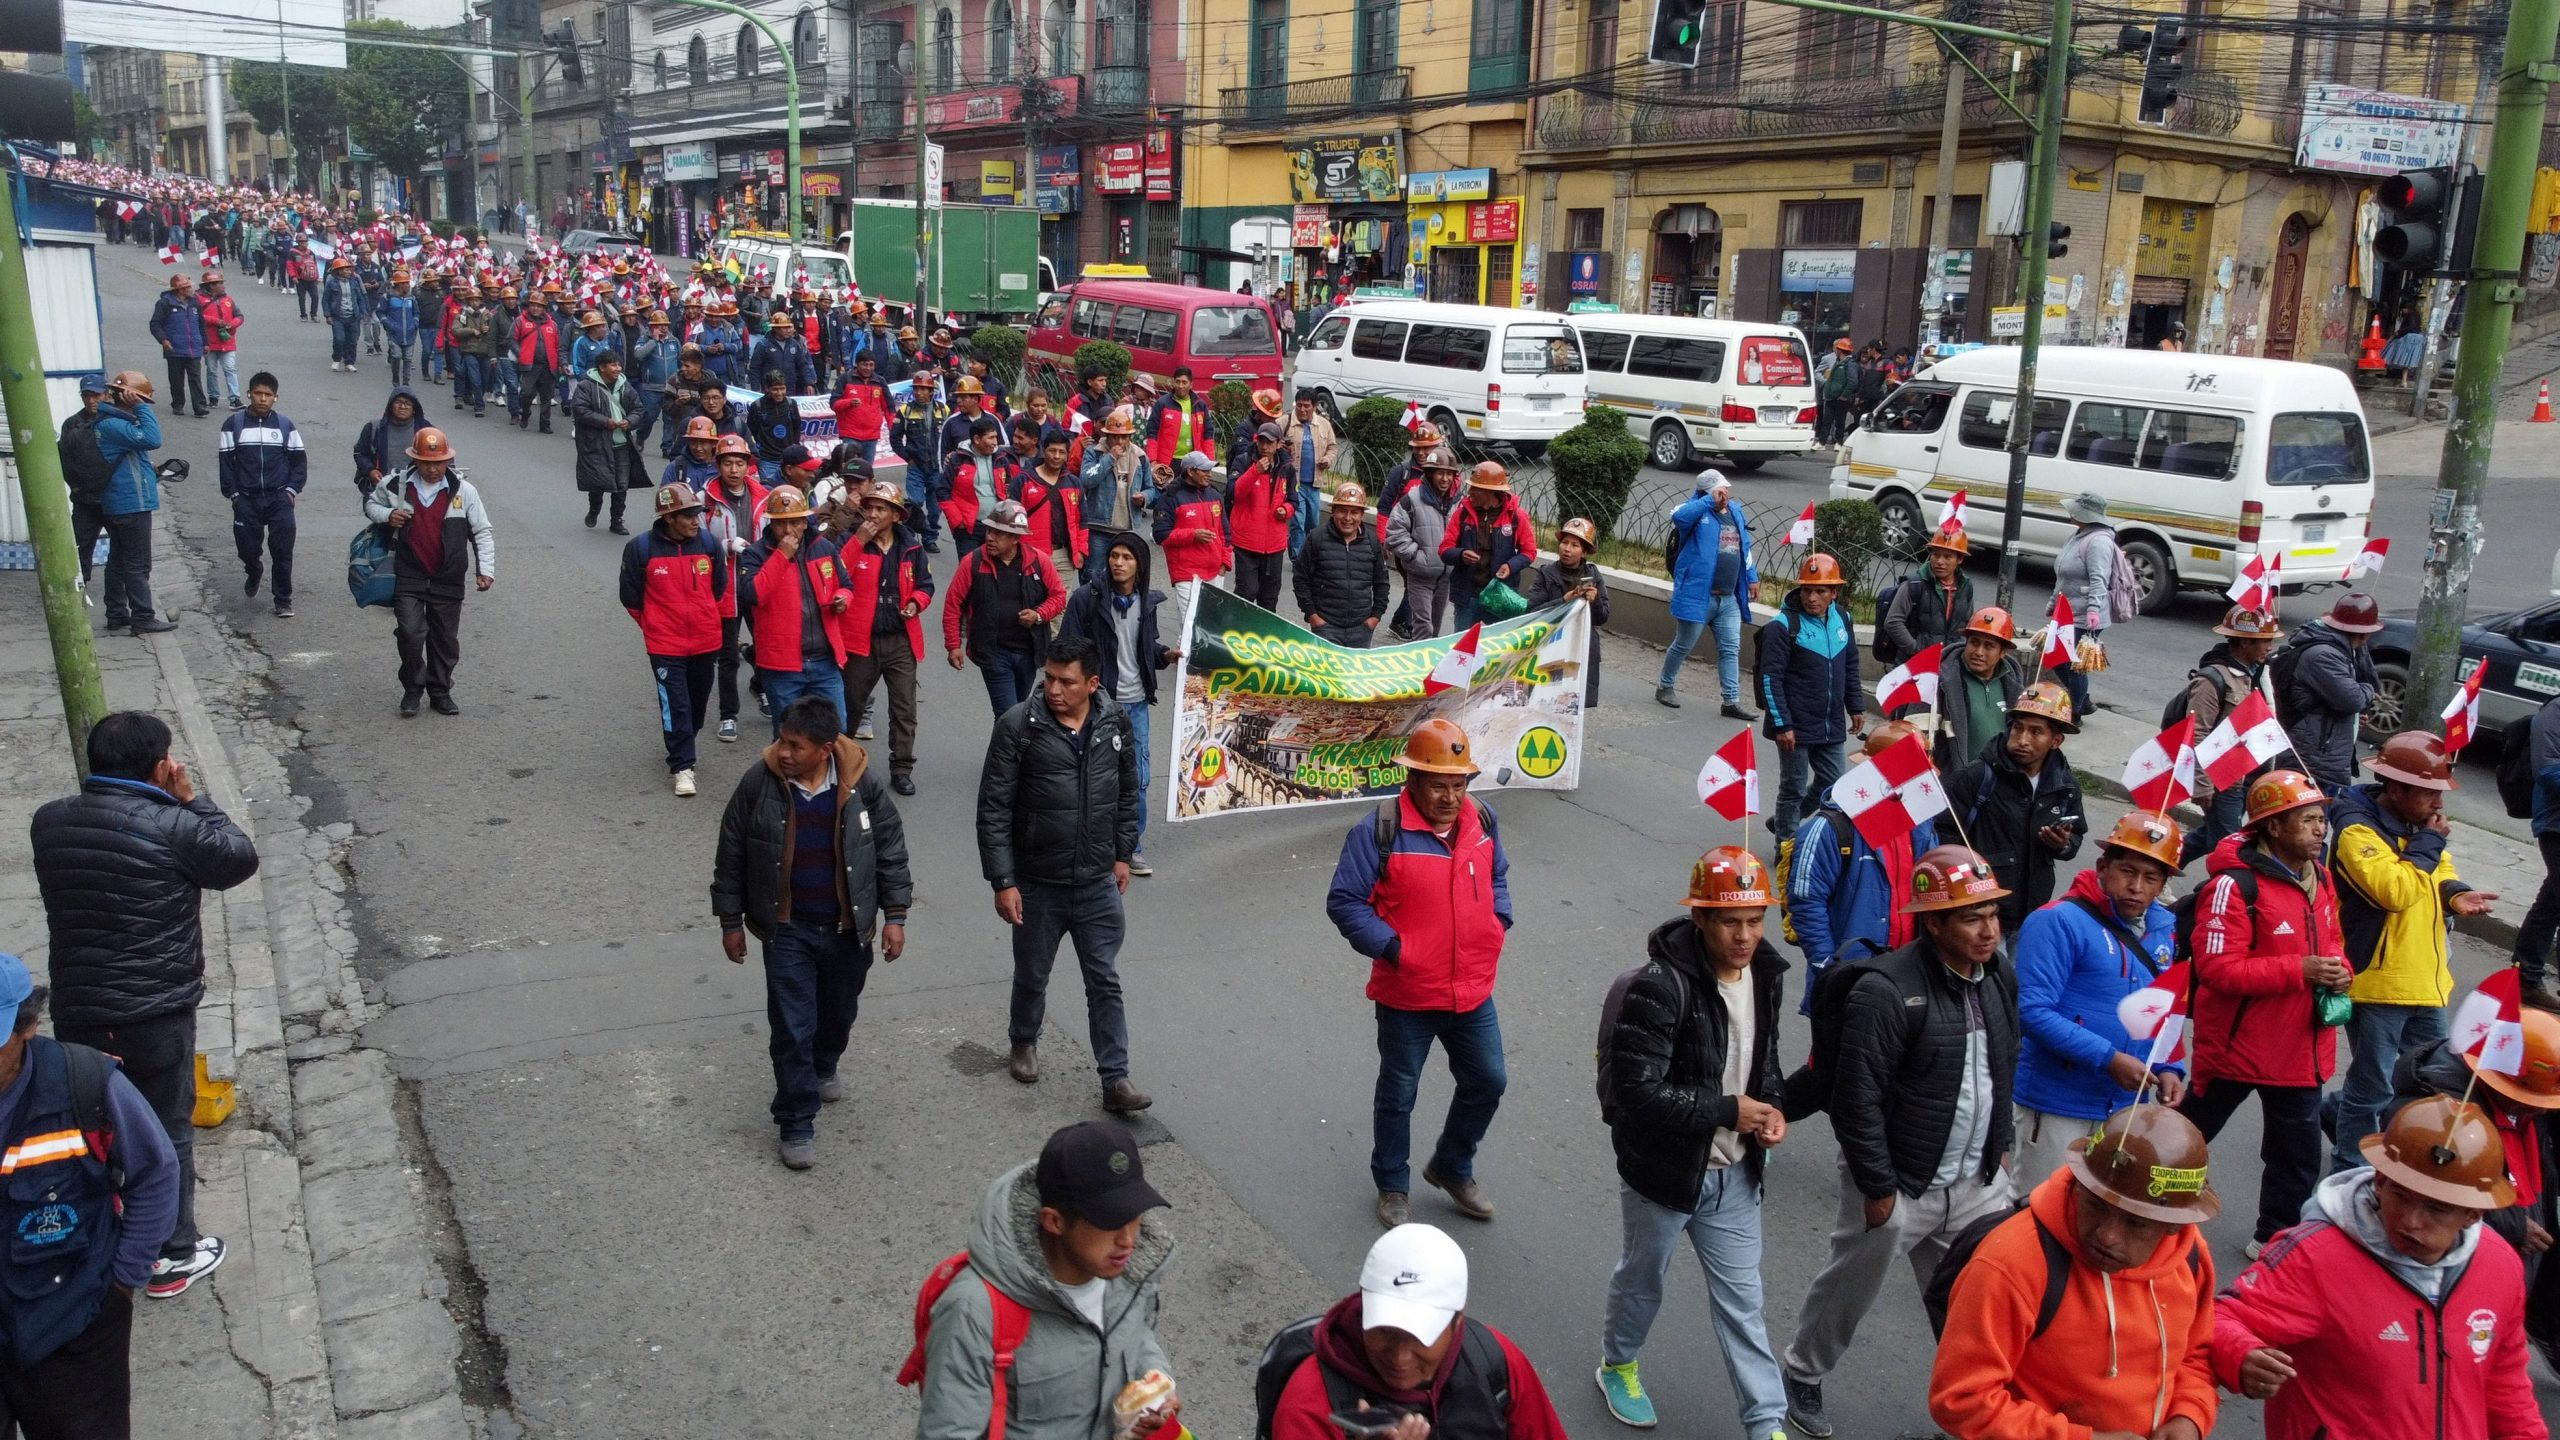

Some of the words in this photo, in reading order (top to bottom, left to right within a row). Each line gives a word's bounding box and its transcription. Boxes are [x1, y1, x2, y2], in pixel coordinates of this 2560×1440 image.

[1325, 139, 1360, 150] TRUPER
[672, 155, 701, 168] FARMACIA
[1327, 162, 1351, 180] ST
[1414, 185, 1431, 195] GOLDEN
[680, 211, 688, 258] FARMACIA
[1800, 262, 1826, 276] General
[1998, 321, 2023, 330] MONT
[1766, 364, 1801, 374] Comercial
[1294, 763, 1355, 790] POTOSÍ
[1368, 764, 1408, 788] BOLI
[1721, 891, 1764, 901] POTOSI
